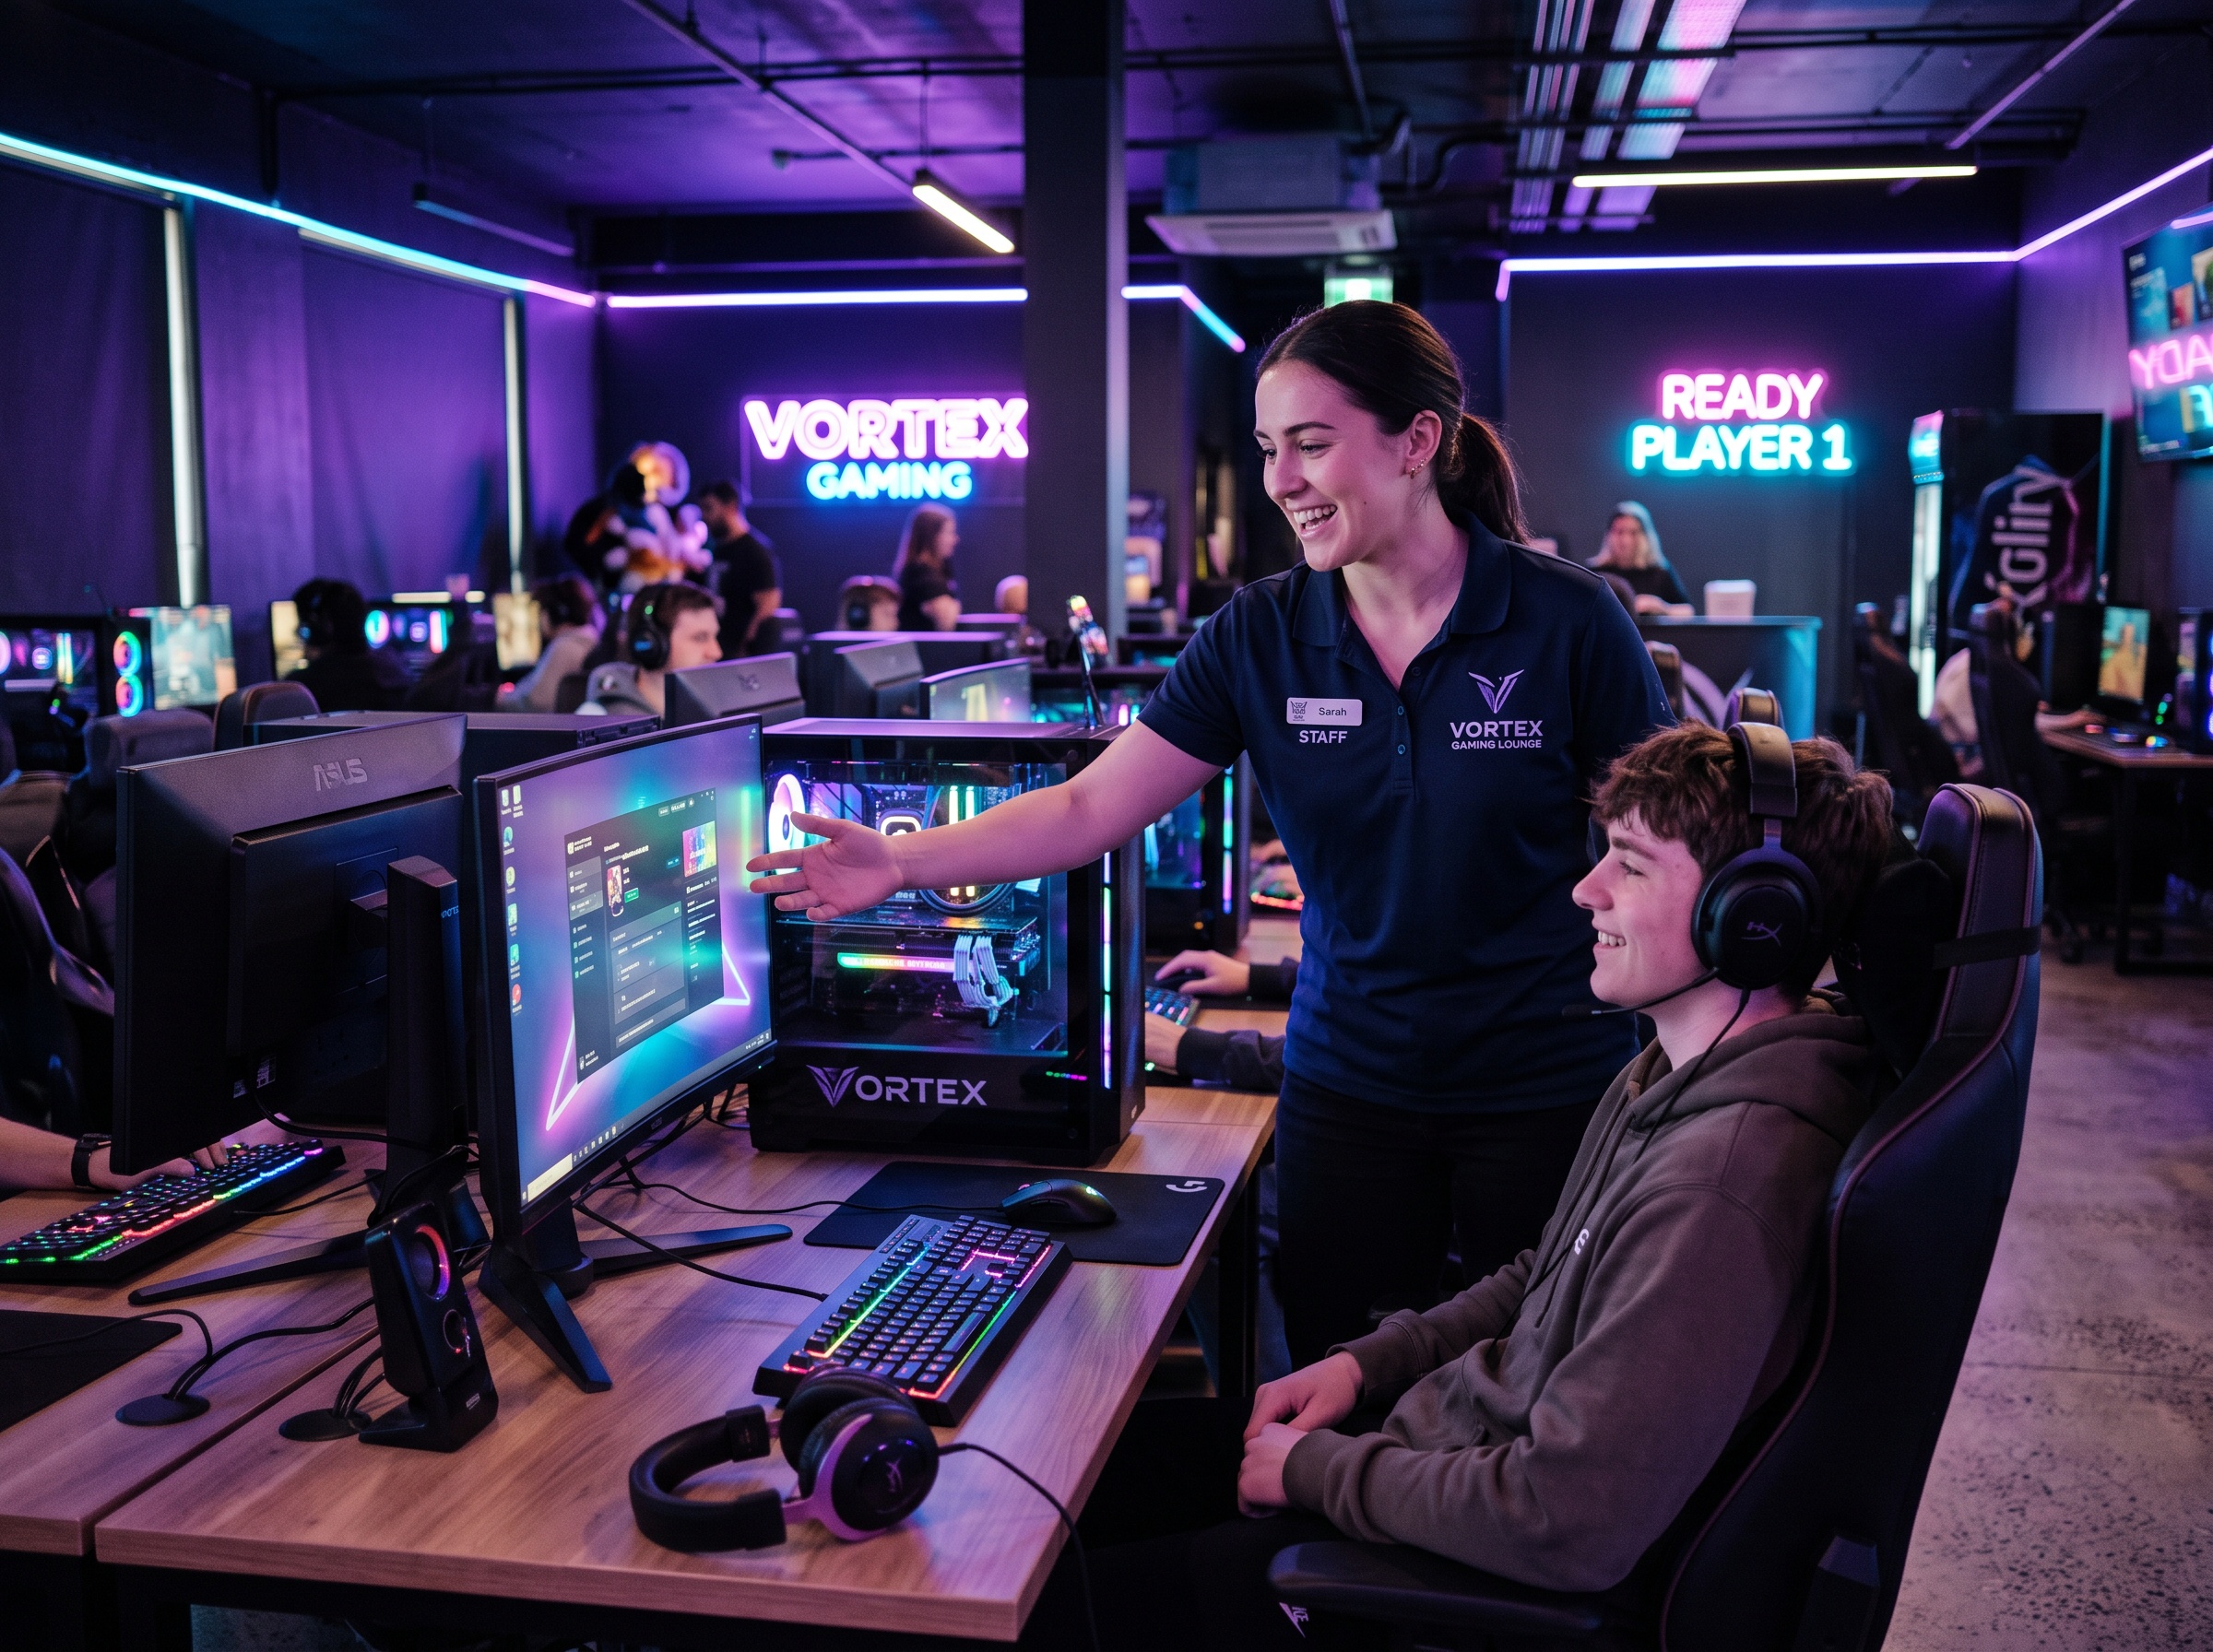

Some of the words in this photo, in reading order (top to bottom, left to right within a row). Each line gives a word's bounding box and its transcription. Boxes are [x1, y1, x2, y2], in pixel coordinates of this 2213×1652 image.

[1662, 373, 1824, 420] READY
[743, 397, 1029, 460] VORTEX
[1632, 424, 1814, 471] PLAYER
[1821, 423, 1852, 470] 1
[806, 460, 973, 500] GAMING
[1319, 707, 1347, 716] Sarah
[1298, 729, 1348, 744] STAFF
[1450, 720, 1544, 738] VORTEX
[1451, 740, 1496, 750] GAMING
[1498, 739, 1542, 749] LOUNGE
[313, 758, 368, 792] ASUS
